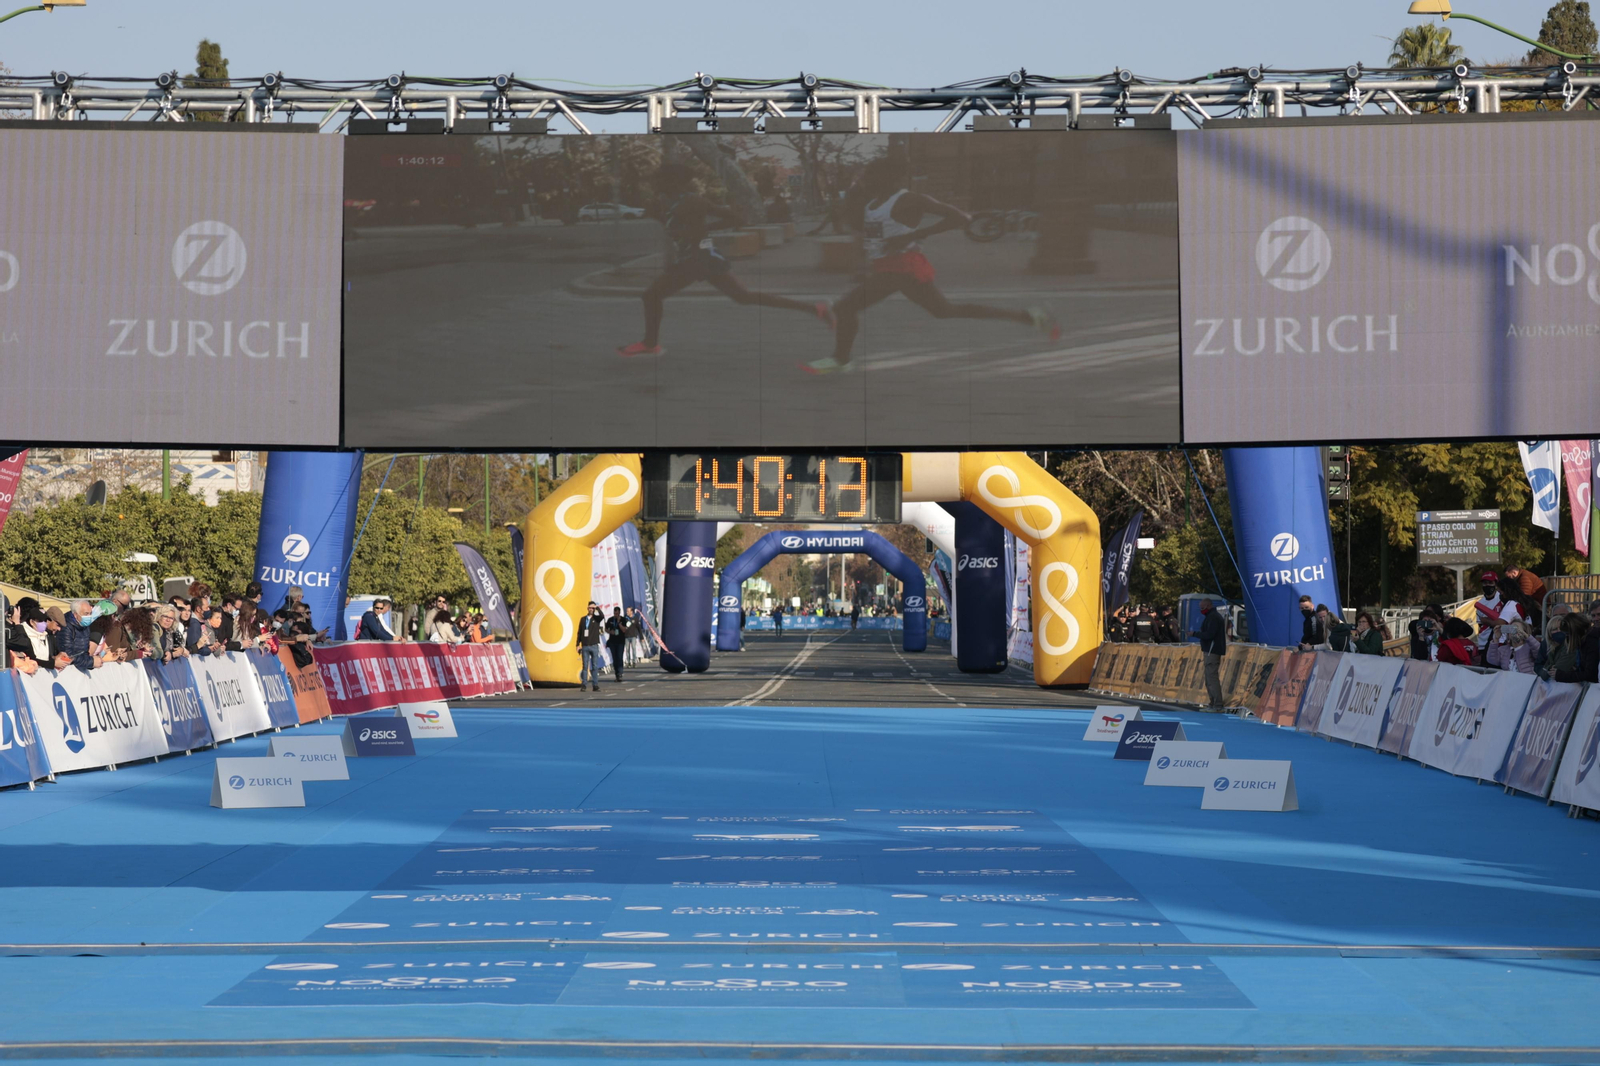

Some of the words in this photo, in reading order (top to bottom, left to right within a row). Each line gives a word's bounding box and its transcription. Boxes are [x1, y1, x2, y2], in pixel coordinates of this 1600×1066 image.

[397, 156, 445, 165] 1:40:12
[105, 319, 310, 359] ZURICH
[1193, 314, 1399, 356] ZURICH
[696, 456, 866, 518] 1:40:13
[1426, 523, 1451, 531] PASEO
[1452, 522, 1476, 531] COLON
[1484, 521, 1499, 530] 273
[1426, 531, 1454, 539] TRIANA
[806, 537, 864, 547] HYUNDAI
[1427, 539, 1447, 547] ZONA
[1448, 538, 1478, 546] CENTRO
[1427, 546, 1478, 555] CAMPAMENTO
[691, 556, 714, 569] asics
[968, 557, 998, 569] asics
[1119, 542, 1133, 573] asics
[260, 566, 330, 587] ZURICH
[1254, 564, 1325, 588] ZURICH
[216, 679, 245, 708] ZURICH
[262, 674, 288, 703] ZURICH
[166, 687, 202, 722] ZURICH
[1347, 681, 1382, 717] ZURICH
[80, 692, 139, 733] ZURICH
[1449, 704, 1486, 740] ZURICH
[371, 730, 397, 739] asics
[1137, 734, 1162, 744] asics
[300, 754, 337, 762] ZURICH
[1172, 759, 1209, 768] ZURICH
[249, 777, 292, 787] ZURICH
[1233, 780, 1277, 790] ZURICH
[410, 920, 592, 928] ZURICH
[362, 960, 565, 969] ZURICH
